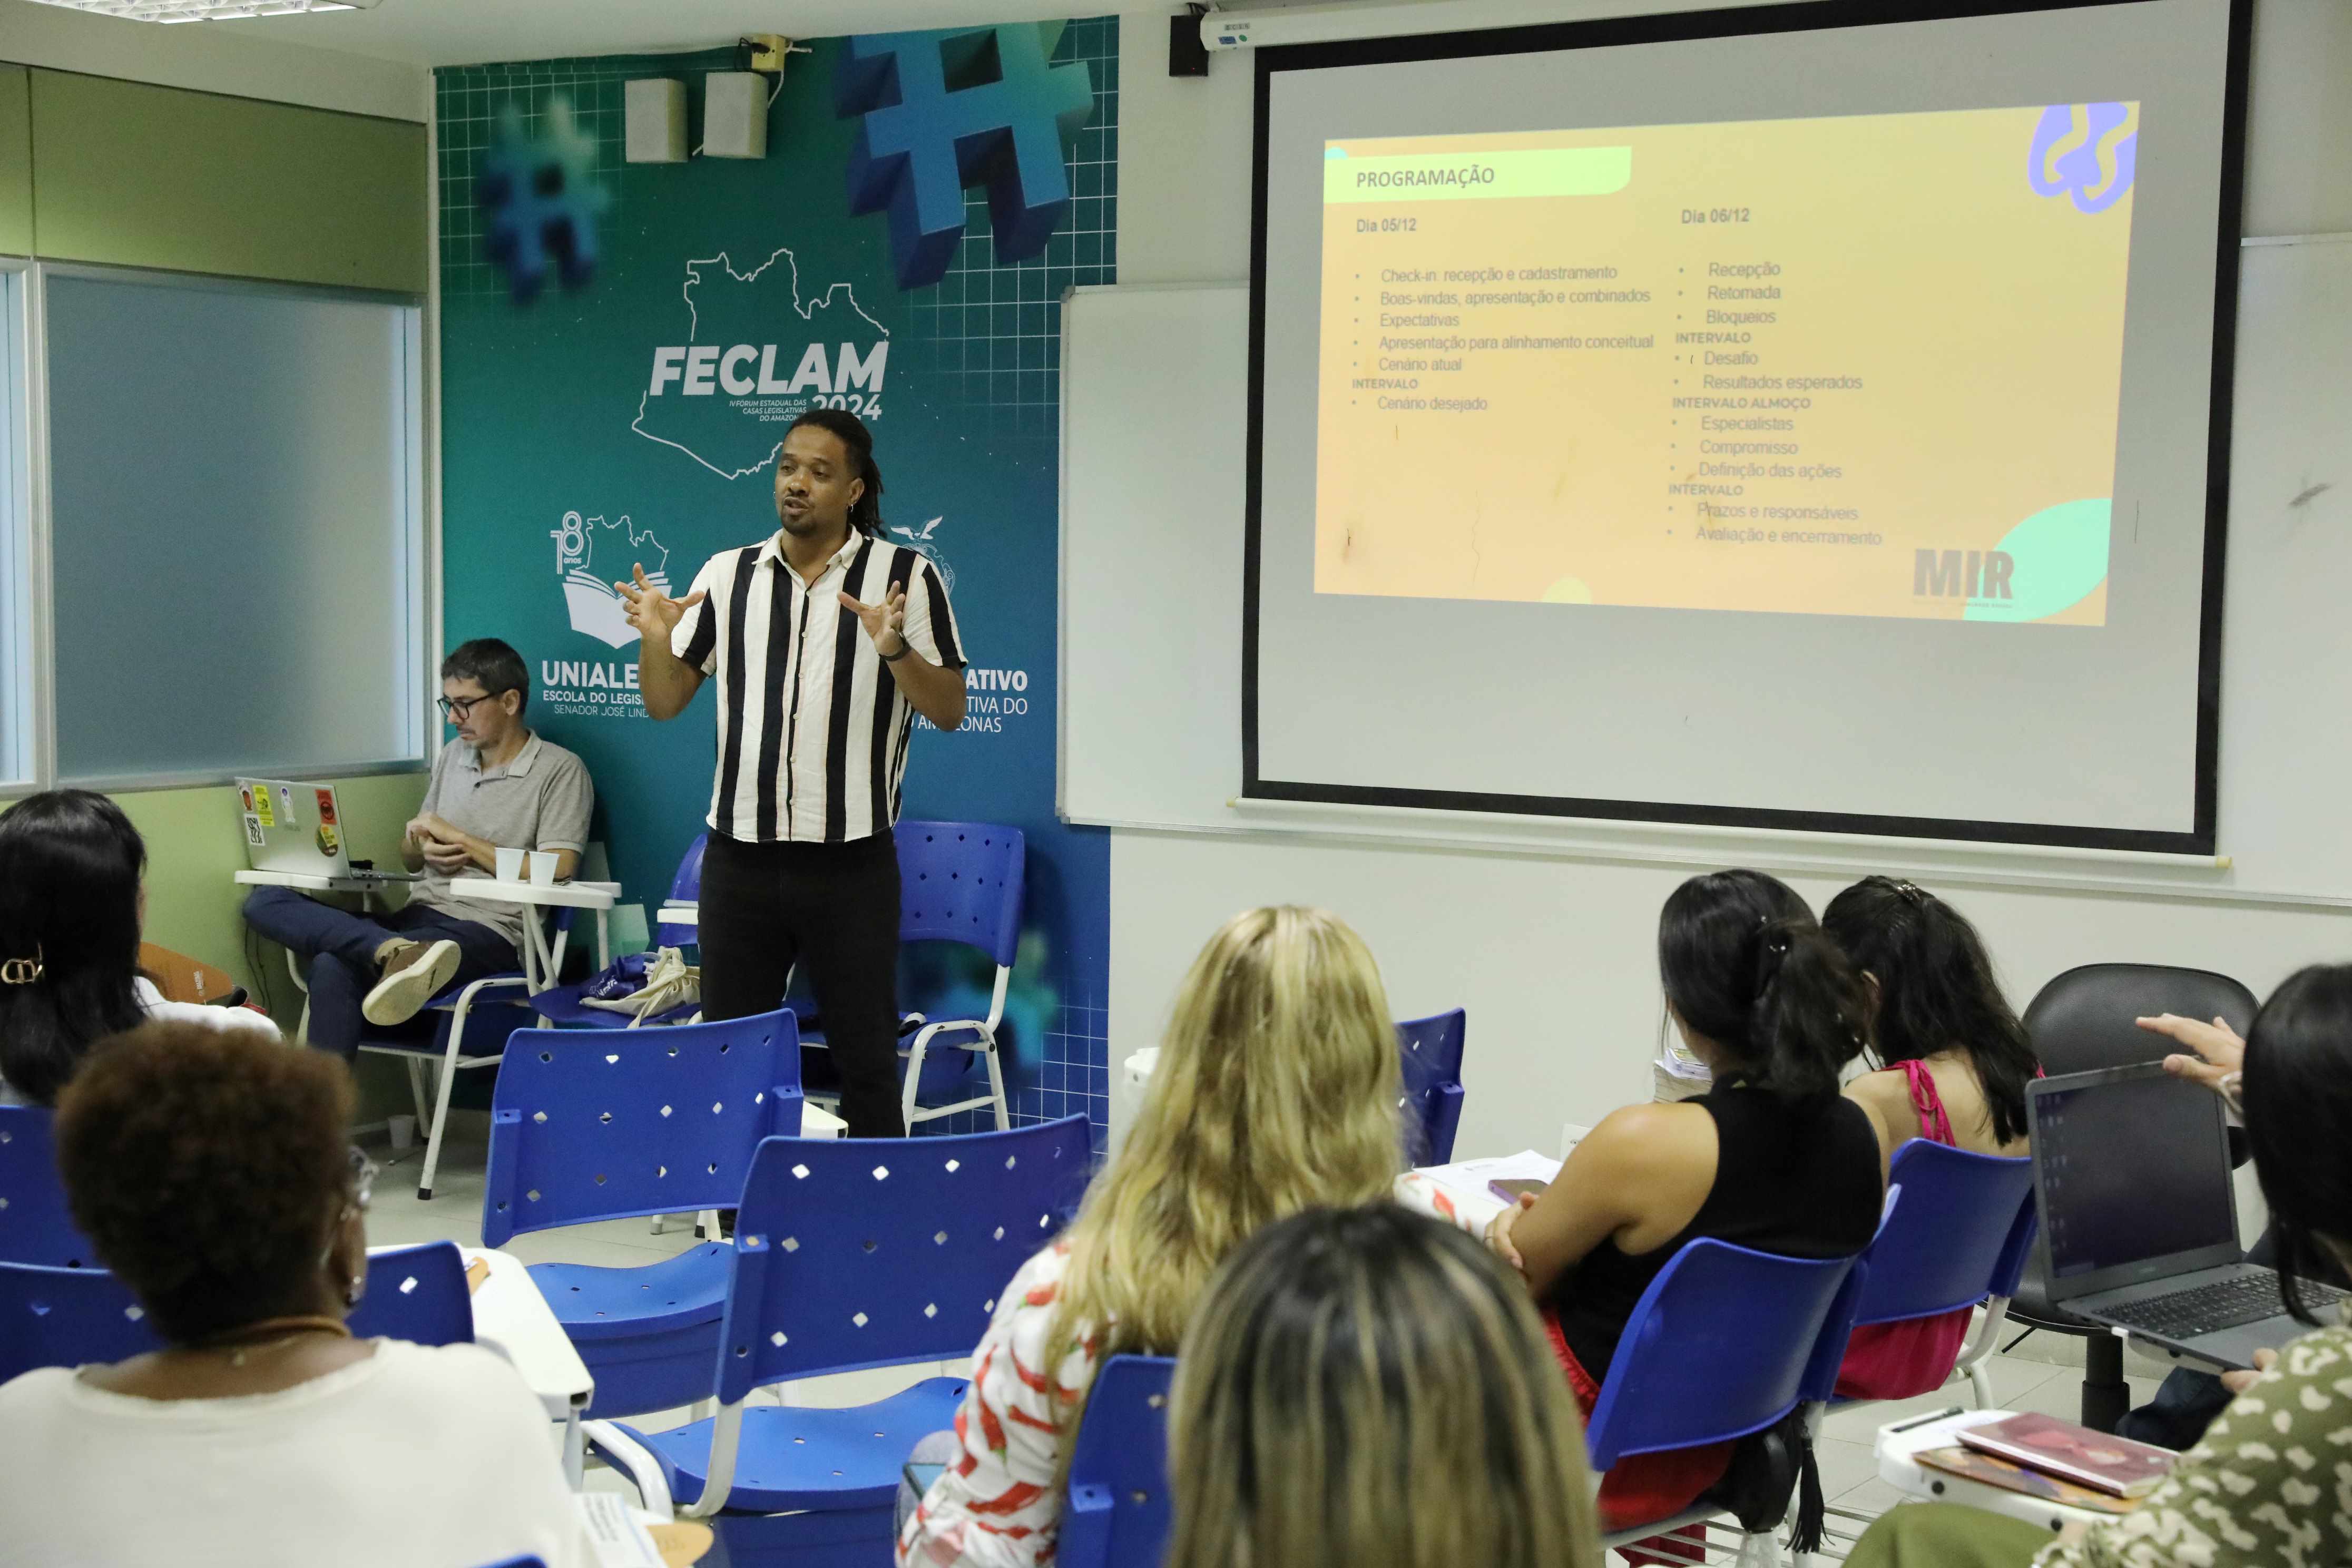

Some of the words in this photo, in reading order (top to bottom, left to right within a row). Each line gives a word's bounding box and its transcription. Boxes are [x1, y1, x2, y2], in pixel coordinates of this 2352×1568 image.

[1356, 164, 1495, 188] PROGRAMAÇÃO
[1356, 219, 1377, 232] Dia
[1381, 217, 1417, 231] 05/12
[1681, 209, 1706, 223] Dia
[1710, 208, 1750, 222] 06/12
[1444, 268, 1503, 284] recepção
[1506, 271, 1515, 280] e
[1518, 266, 1618, 280] cadastramento
[1709, 261, 1780, 279] Recepção
[1380, 291, 1462, 308] Boas-vindas,
[1465, 290, 1554, 306] apresentação
[1556, 292, 1565, 303] e
[1570, 288, 1651, 303] combinados
[1708, 284, 1780, 300] Retomada
[1380, 313, 1460, 328] Expectativas
[1706, 309, 1776, 326] Bloqueios
[1379, 336, 1466, 352] Apresentação
[1468, 338, 1499, 351] para
[1502, 336, 1582, 349] alinhamento
[1585, 334, 1654, 349] conceitual
[1675, 332, 1751, 344] INTERVALO
[1379, 357, 1427, 371] Cenário
[1431, 357, 1462, 371] atual
[1704, 350, 1758, 365] Desafio
[650, 341, 889, 396] FECLAM
[1352, 379, 1418, 389] INTERVALO
[1703, 374, 1782, 389] Resultados
[1786, 375, 1863, 391] esperados
[812, 394, 882, 420] 2024
[1377, 396, 1426, 410] Cenário
[1429, 397, 1488, 413] desejado
[1672, 397, 1747, 409] INTERVALO
[1751, 397, 1811, 411] ALMOÇO
[1701, 415, 1794, 433] Especialistas
[1700, 439, 1799, 457] Compromisso
[1699, 462, 1765, 479] Definição
[1769, 463, 1795, 477] das
[1798, 464, 1842, 481] ações
[1668, 483, 1743, 496] INTERVALO
[1697, 502, 1746, 518] Prazos
[1750, 506, 1759, 518] e
[1762, 505, 1859, 521] responsáveis
[1696, 527, 1765, 544] Avaliação
[1768, 531, 1777, 542] e
[1781, 531, 1882, 546] encerramento
[1913, 548, 2015, 599] MIR
[542, 660, 639, 689] UNIALE
[965, 669, 1028, 691] ATIVO
[543, 690, 586, 702] ESCOLA
[590, 692, 606, 703] DO
[611, 693, 644, 705] LEGIS
[966, 696, 999, 713] TIVA
[1004, 698, 1028, 715] DO
[554, 704, 598, 715] SENADOR
[601, 706, 625, 717] JOSÉ
[629, 708, 649, 718] LIND
